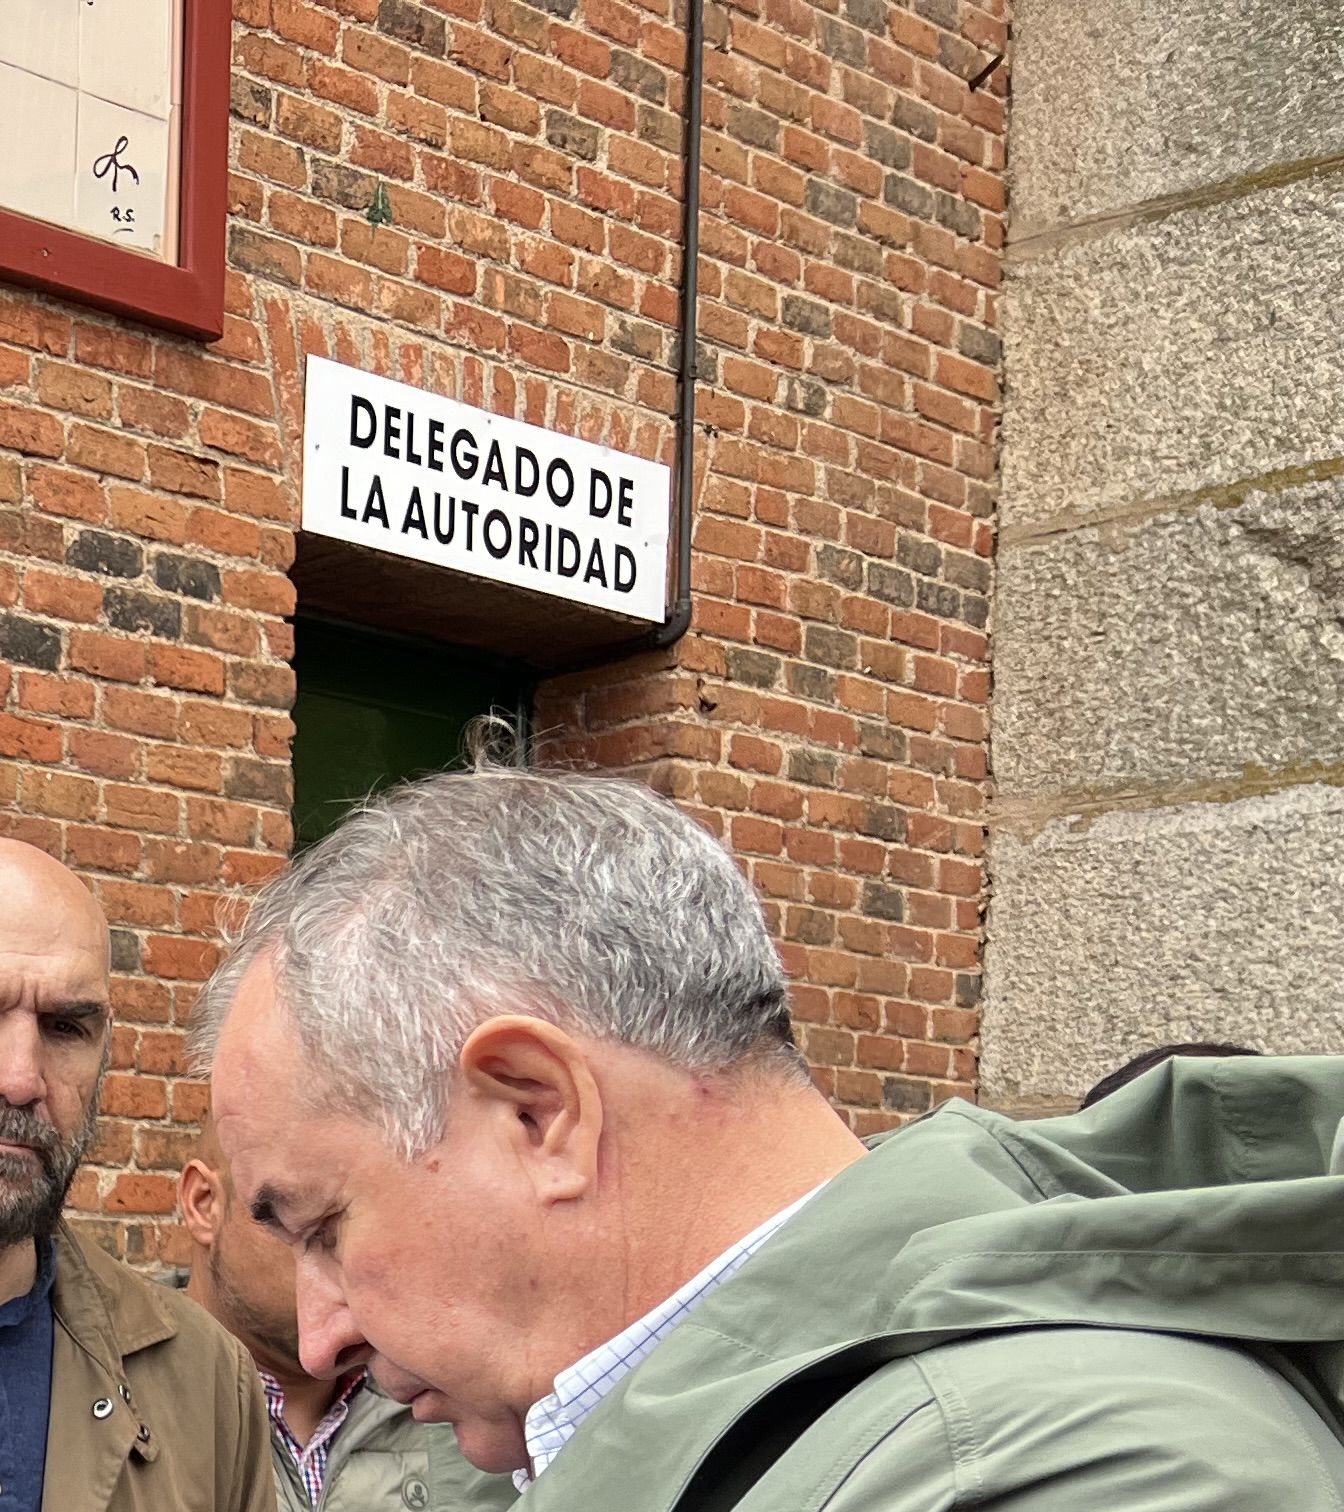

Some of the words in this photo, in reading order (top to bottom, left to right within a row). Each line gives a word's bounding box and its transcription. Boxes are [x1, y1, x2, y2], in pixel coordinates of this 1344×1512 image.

[350, 394, 575, 508] DELEGADO
[589, 467, 634, 528] DE
[340, 465, 390, 529] LA
[401, 486, 637, 594] AUTORIDAD
